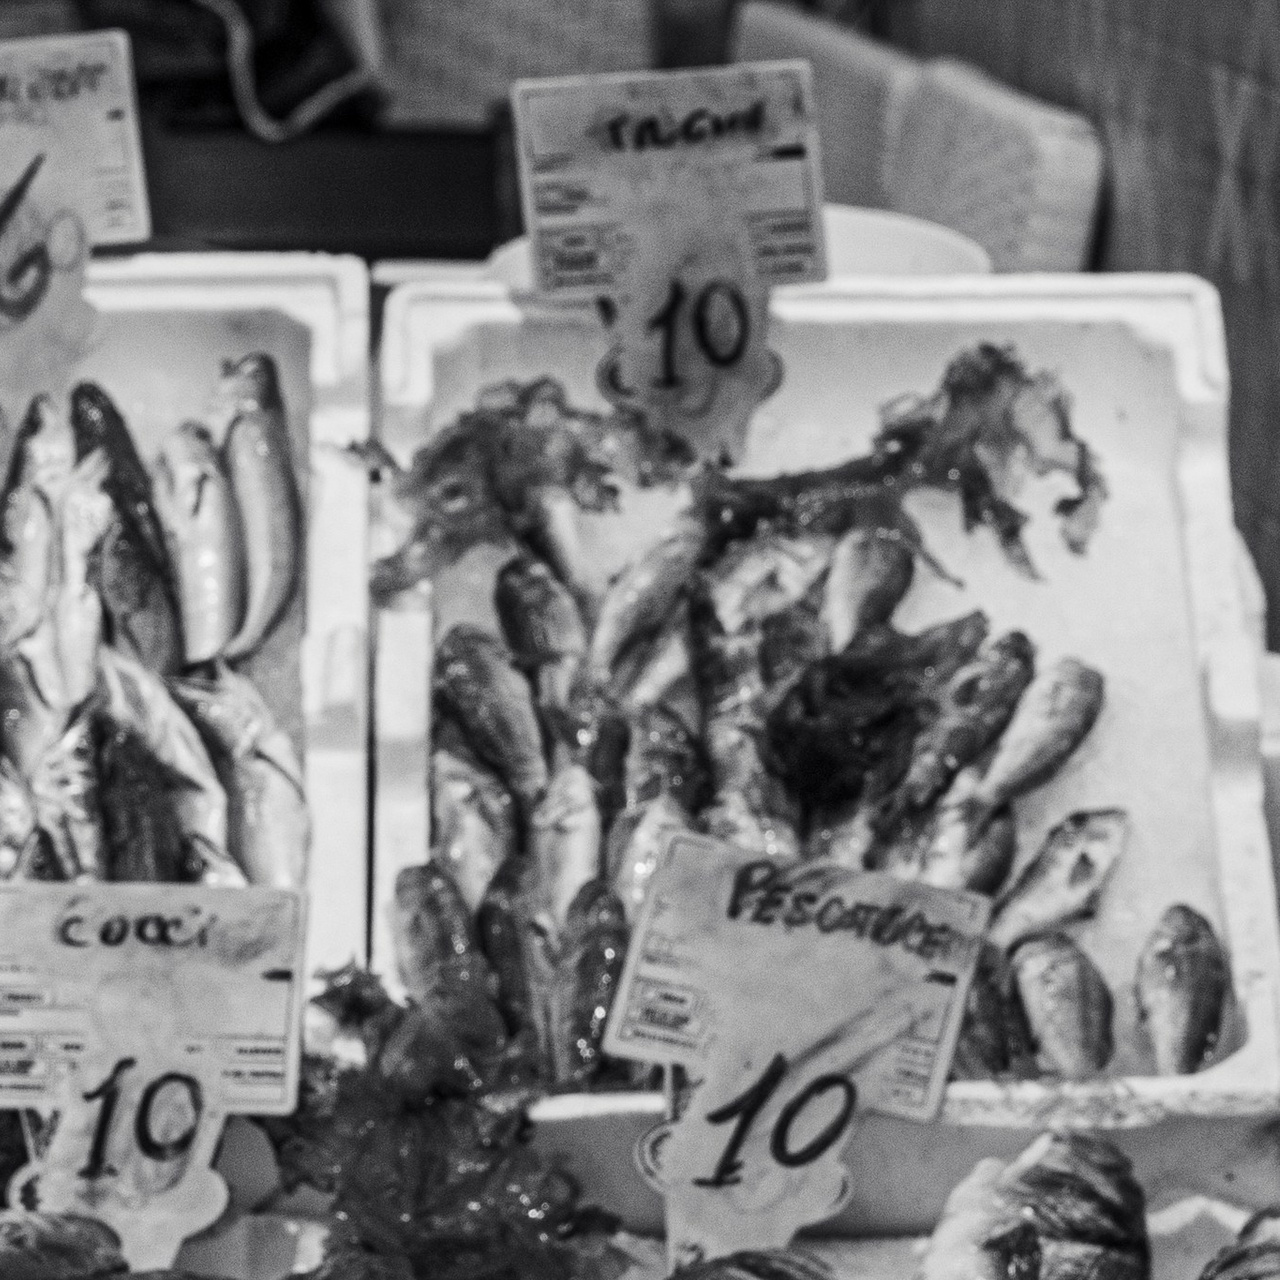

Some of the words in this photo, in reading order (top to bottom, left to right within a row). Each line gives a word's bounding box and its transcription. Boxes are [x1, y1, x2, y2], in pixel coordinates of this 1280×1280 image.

[646, 278, 751, 390] 10
[77, 1056, 204, 1179] 10
[693, 1053, 857, 1188] 10
